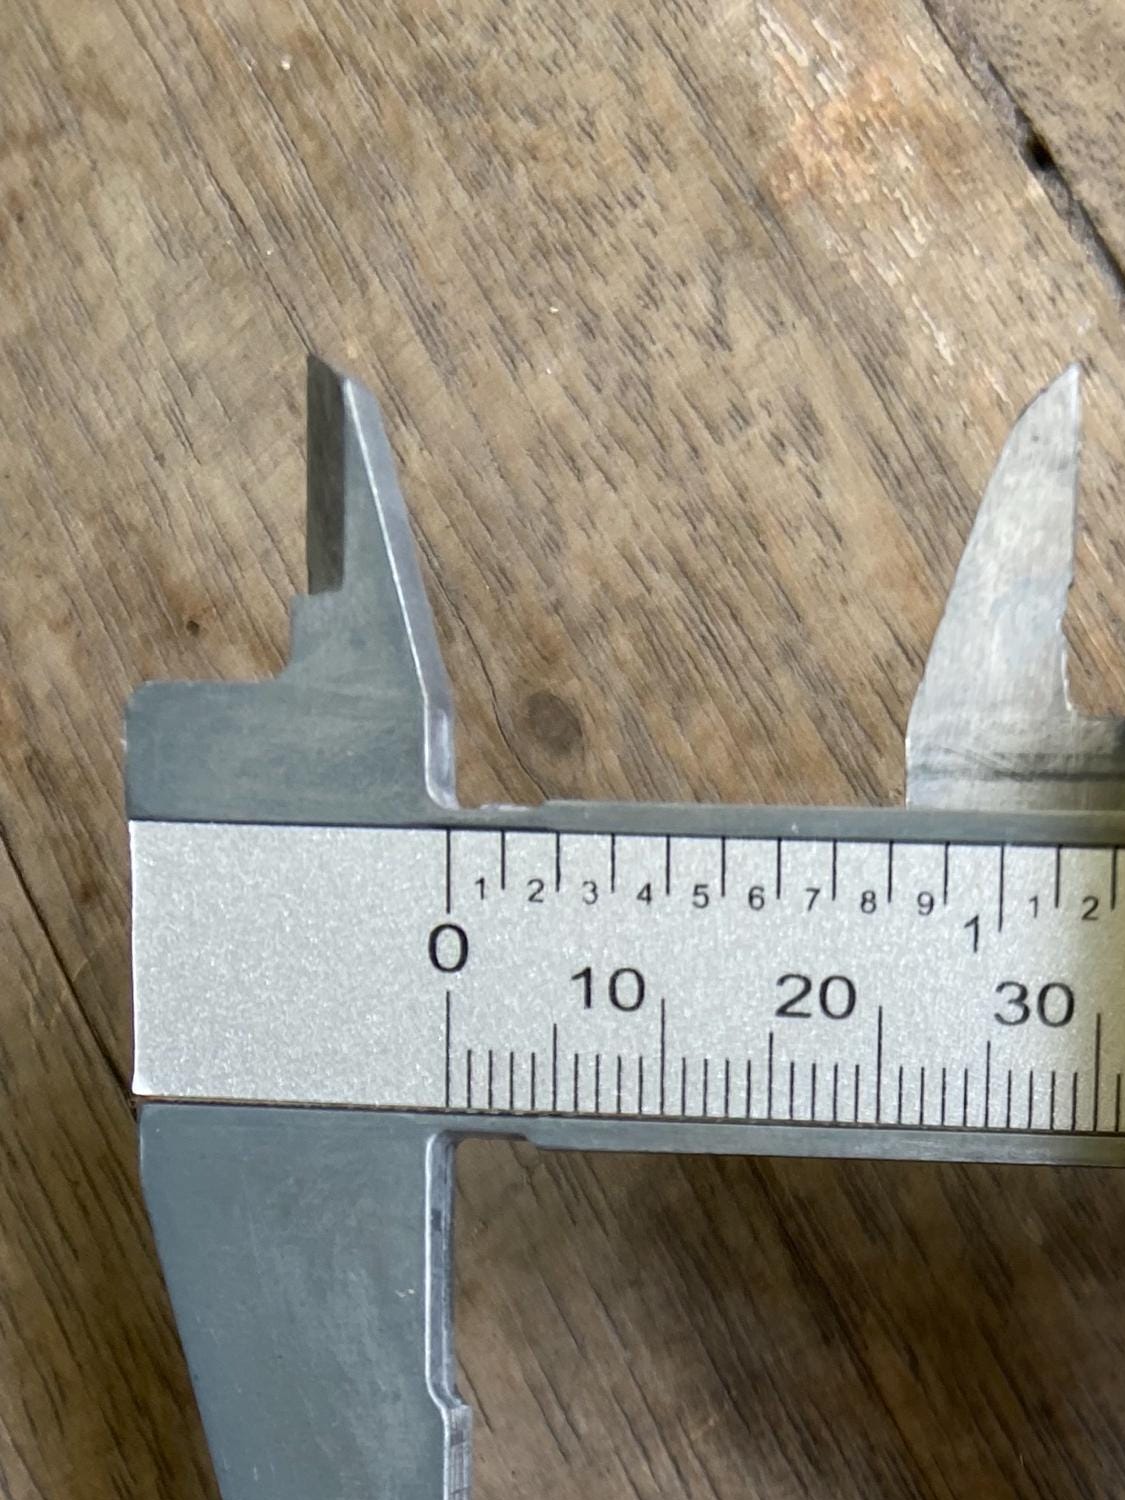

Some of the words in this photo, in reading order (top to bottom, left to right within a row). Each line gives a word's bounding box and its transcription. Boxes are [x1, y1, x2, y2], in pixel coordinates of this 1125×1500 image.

[474, 876, 487, 900] 1
[526, 878, 546, 903] 2
[581, 880, 599, 905] 3
[635, 882, 653, 905] 4
[692, 884, 710, 909] 5
[747, 885, 766, 911] 6
[804, 887, 821, 911] 7
[859, 889, 877, 914] 8
[916, 890, 935, 916] 9
[1027, 895, 1040, 919] 1
[1081, 896, 1100, 921] 2
[963, 914, 980, 953] 1
[427, 922, 470, 973] 0
[570, 966, 646, 1012] 10
[774, 972, 858, 1020] 20
[993, 980, 1076, 1028] 30
